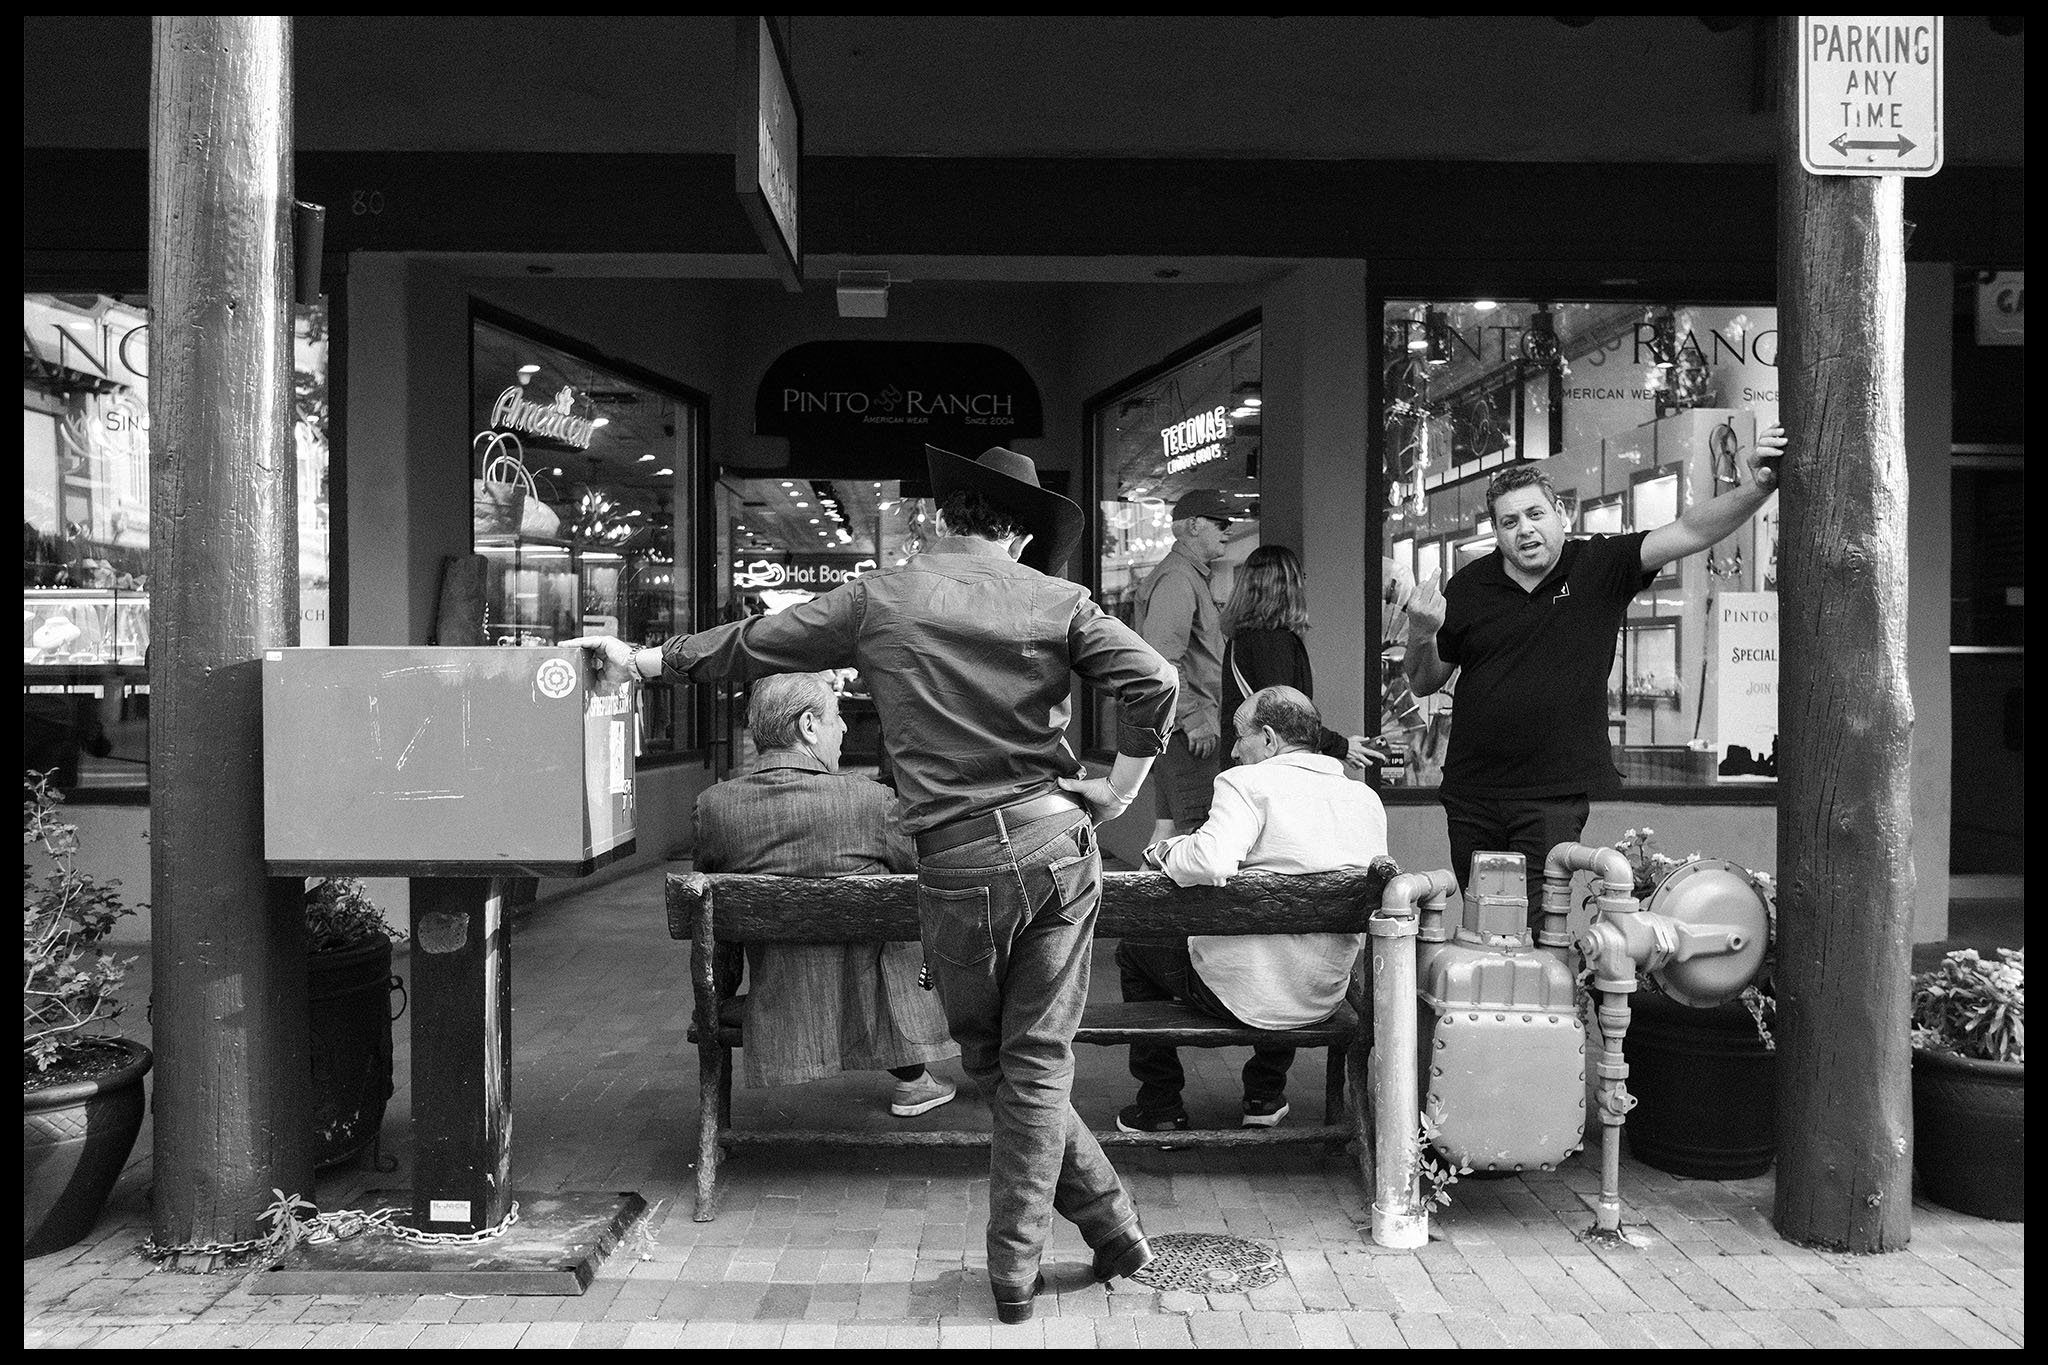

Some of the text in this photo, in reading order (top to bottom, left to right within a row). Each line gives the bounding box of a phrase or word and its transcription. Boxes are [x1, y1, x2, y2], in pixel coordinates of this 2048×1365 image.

[1813, 24, 1930, 65] PARKING
[1846, 69, 1898, 96] ANY
[1840, 102, 1904, 128] TIME
[352, 190, 385, 216] 80
[783, 388, 1013, 415] PINTO RANCH
[1562, 388, 1625, 401] MERICAN
[863, 415, 1015, 426] AMERICAN WEAR SINCE 2004
[1161, 405, 1227, 458] TECOVAS
[786, 564, 849, 583] Hat Bar
[1724, 608, 1769, 624] PINTO
[1731, 646, 1778, 664] SPECIAL
[1746, 682, 1771, 697] JOIN
